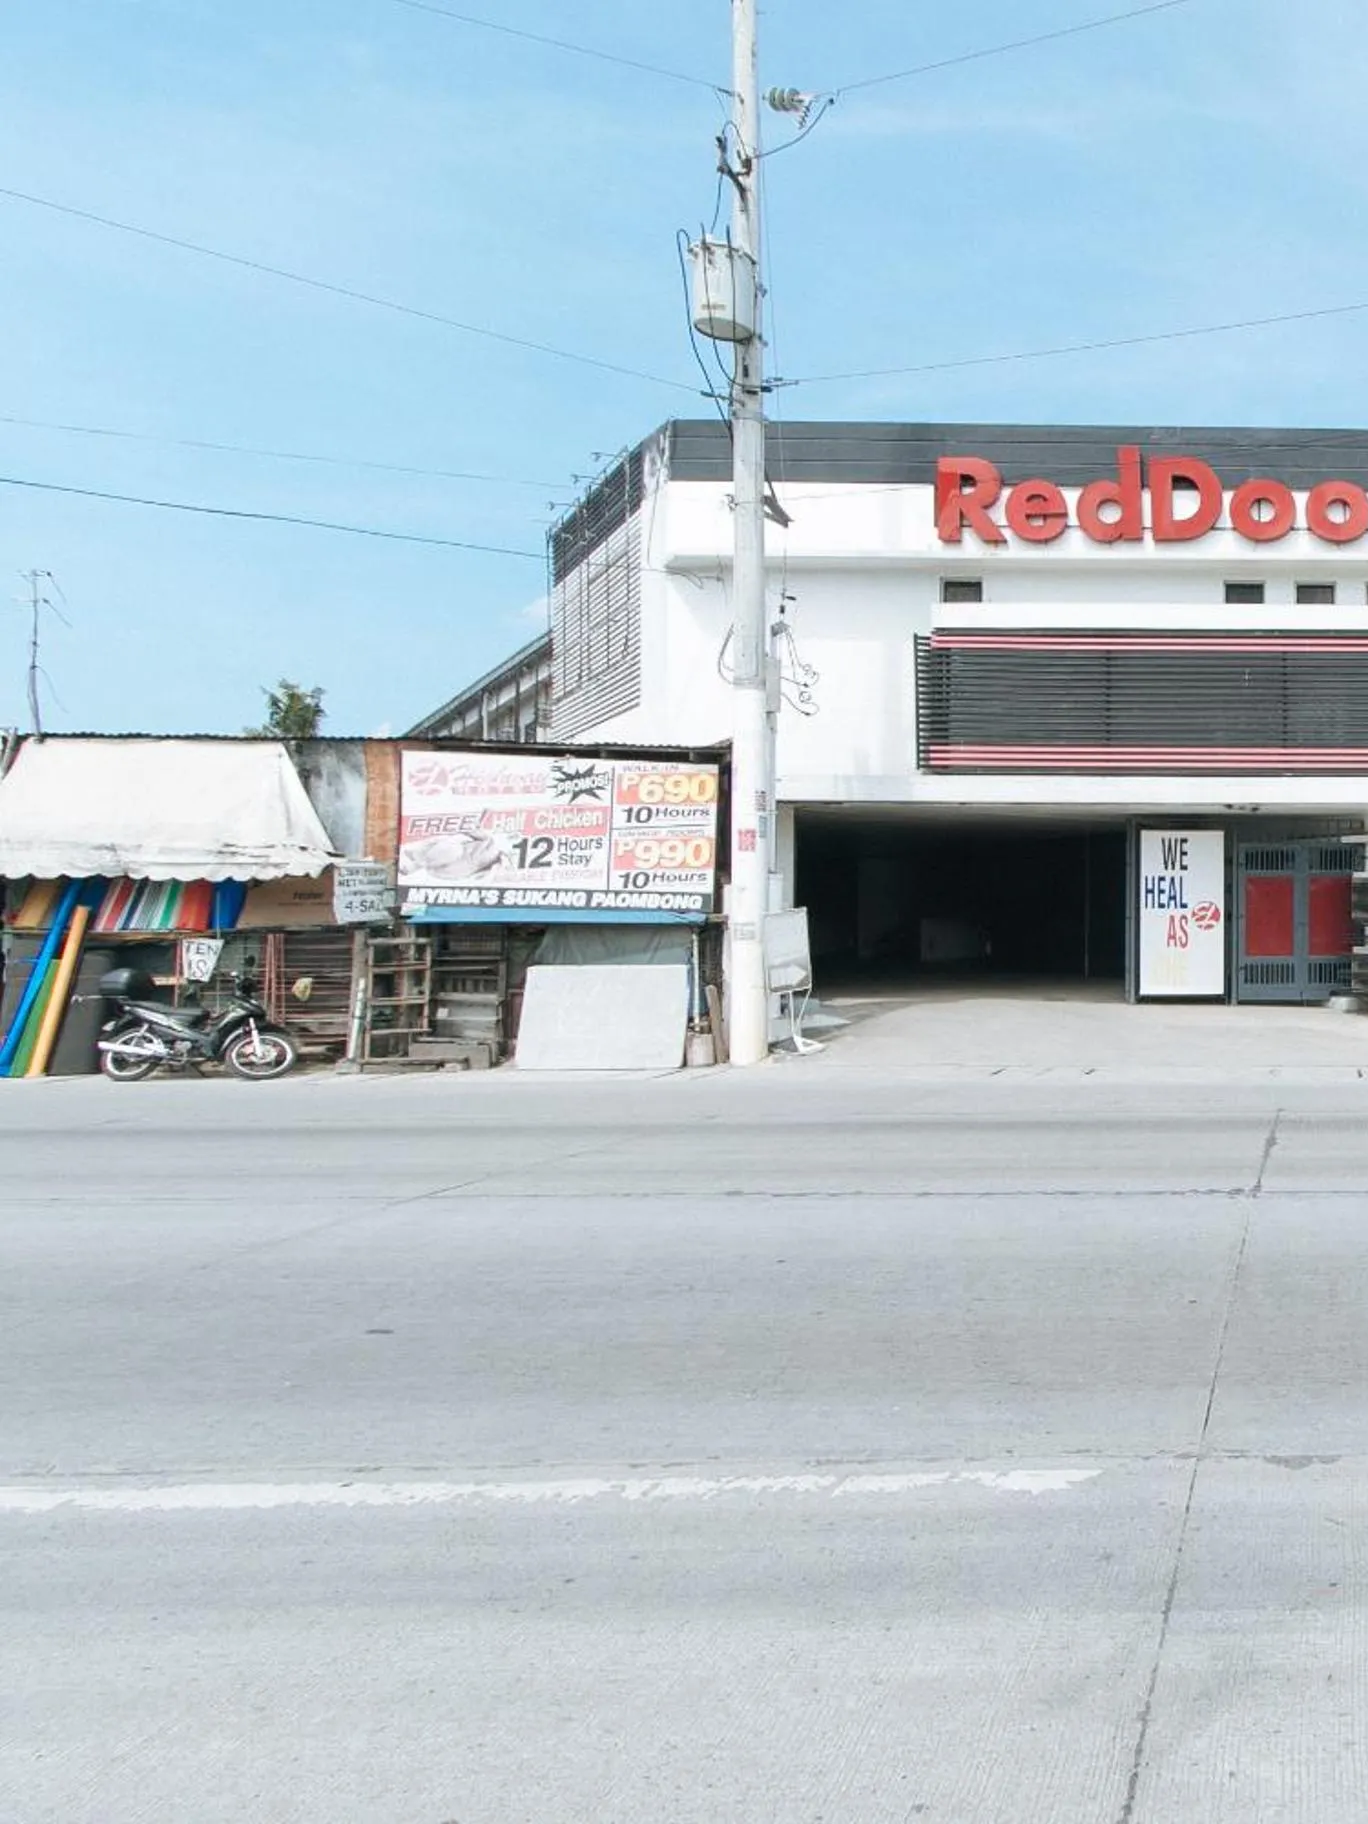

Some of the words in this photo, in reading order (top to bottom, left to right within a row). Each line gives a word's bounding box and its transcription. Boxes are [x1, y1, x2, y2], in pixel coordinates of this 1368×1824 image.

[534, 807, 605, 829] Chicken
[622, 806, 654, 824] 10
[654, 806, 710, 819] Hours
[512, 837, 554, 870] 12
[557, 837, 604, 852] Hours
[558, 853, 593, 868] Stay
[1161, 837, 1189, 871] WE
[618, 872, 650, 890] 10
[653, 872, 708, 884] Hours
[501, 889, 587, 907] SUKANG
[590, 893, 703, 911] PAOMBONG
[1144, 876, 1188, 909] HEAL
[1166, 914, 1189, 949] AS
